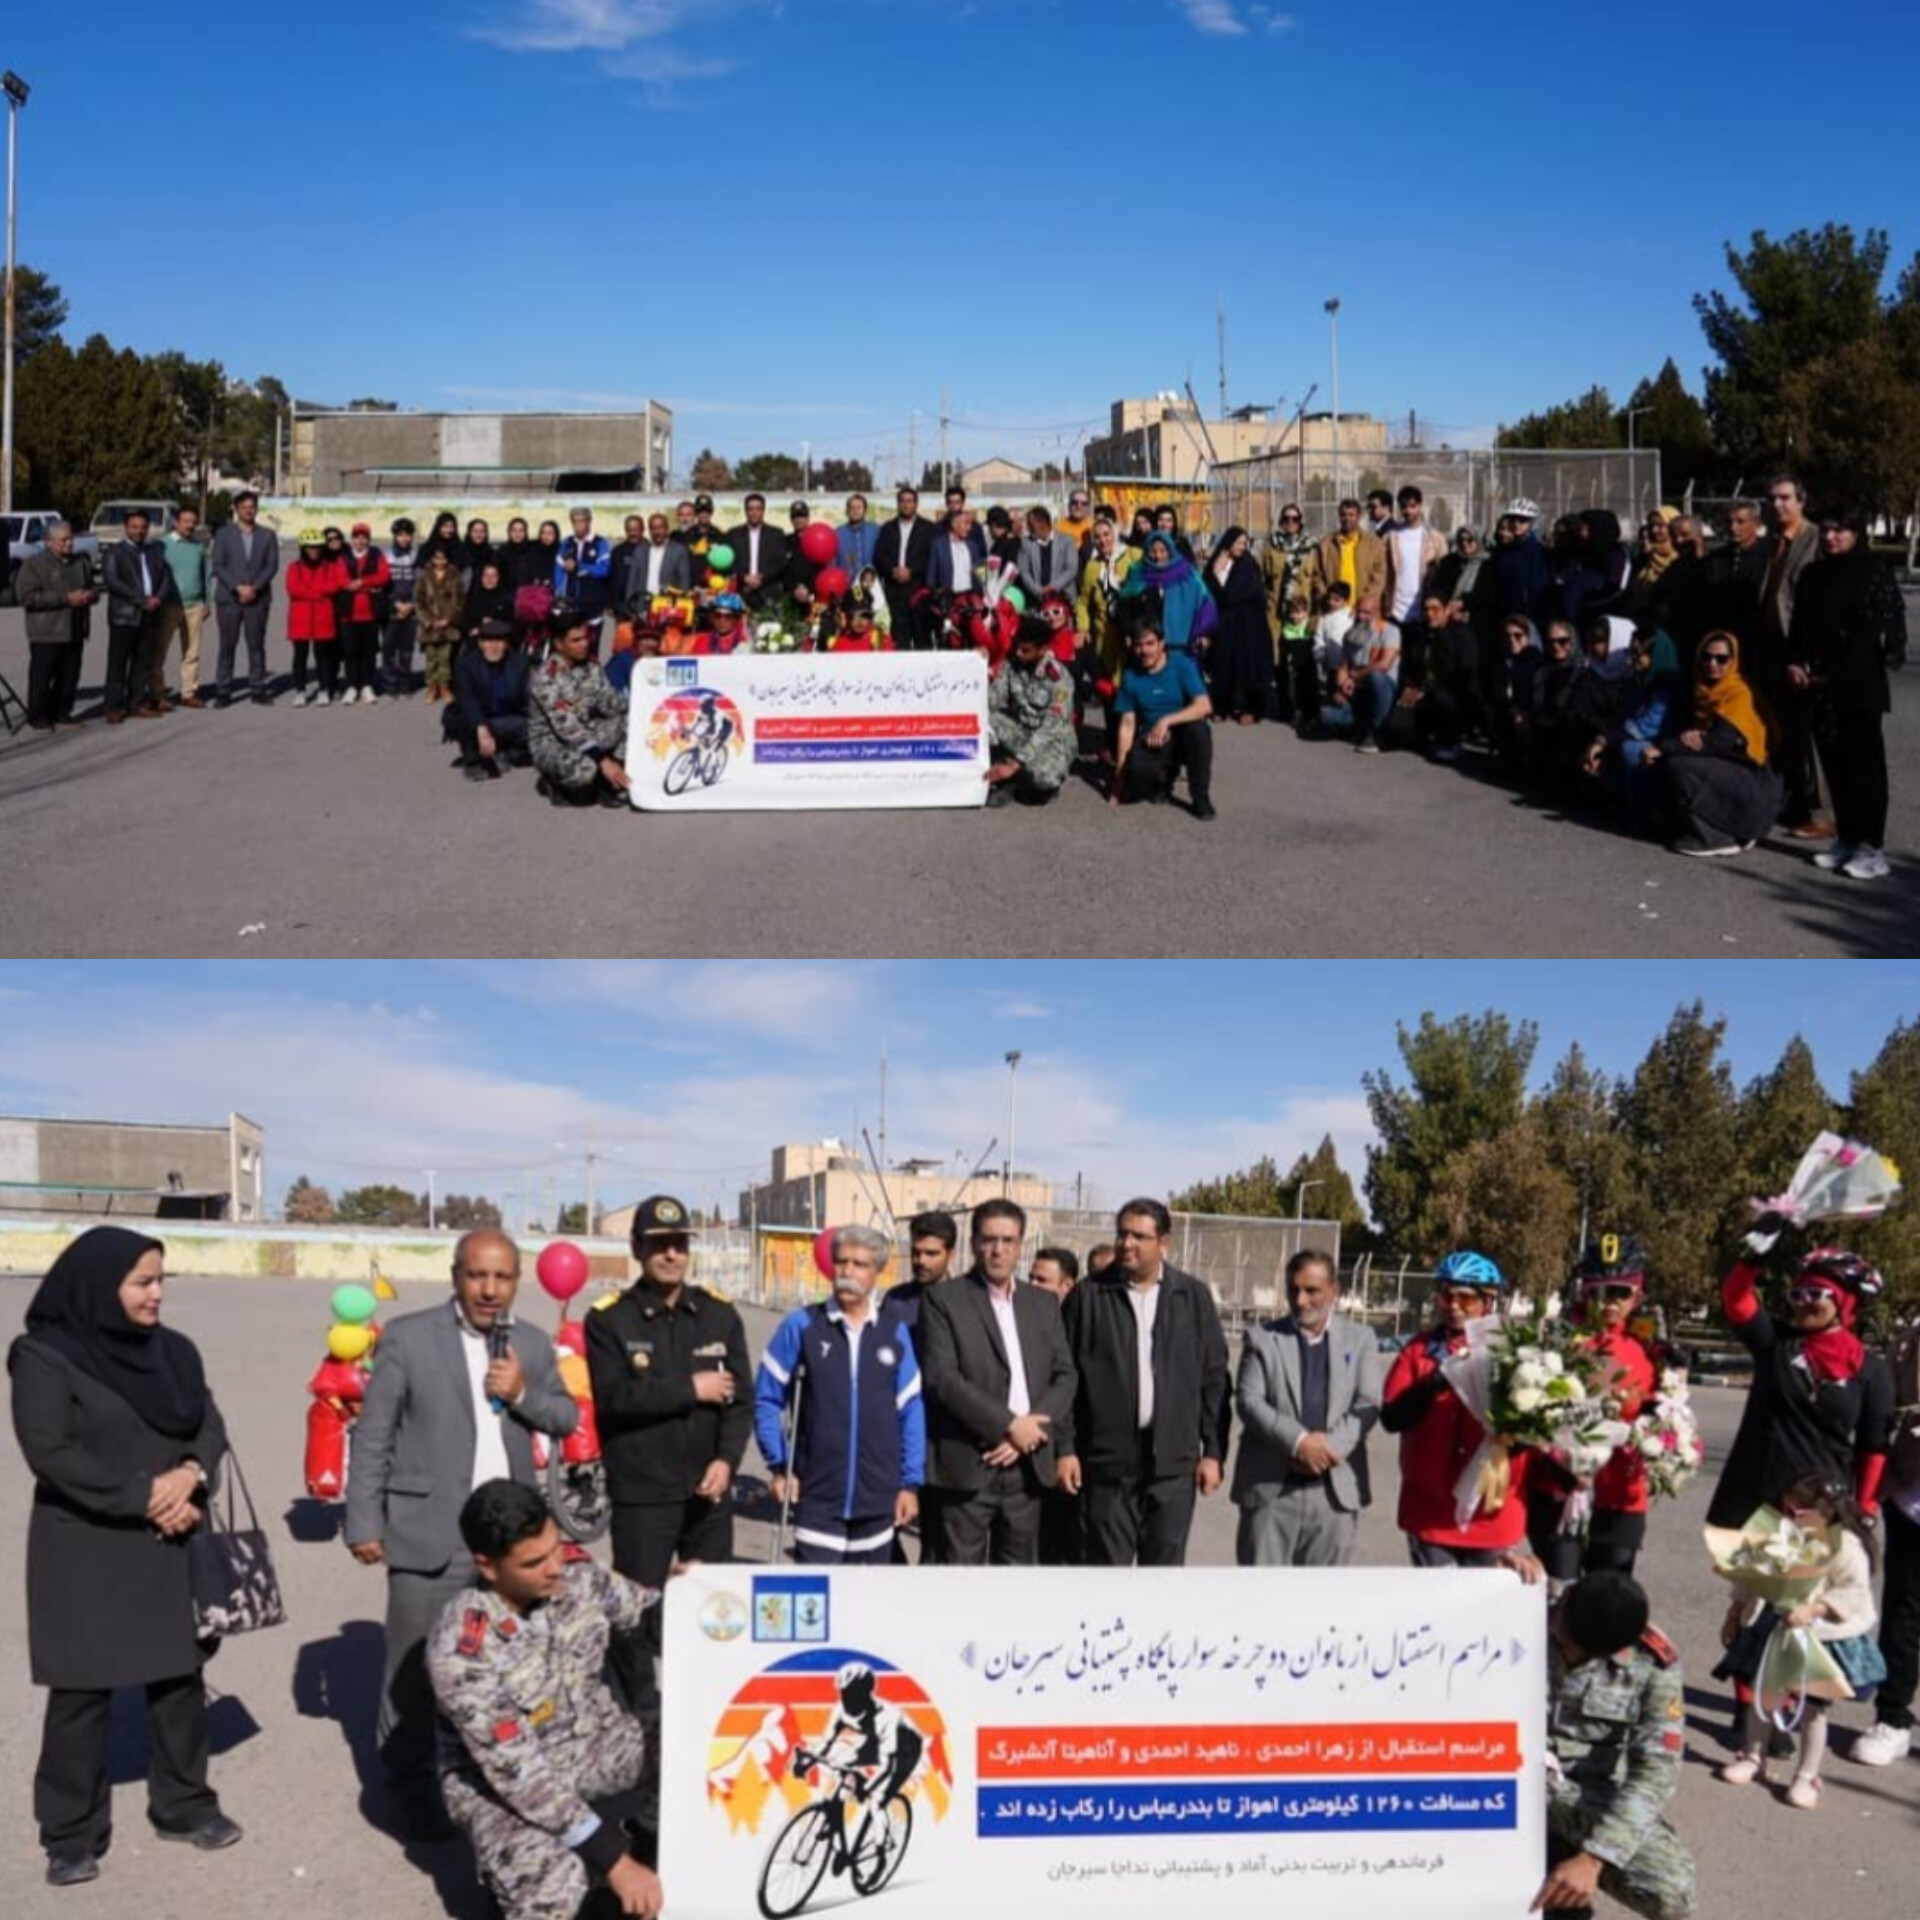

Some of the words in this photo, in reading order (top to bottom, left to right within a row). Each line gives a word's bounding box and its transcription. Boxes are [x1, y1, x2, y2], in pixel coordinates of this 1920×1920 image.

[1065, 1616, 1133, 1693] پشتیبانی
[1180, 1635, 1218, 1670] سوار
[1288, 1625, 1345, 1692] بانوان
[1348, 1633, 1369, 1669] از
[1371, 1624, 1445, 1692] استقبال
[984, 1641, 1064, 1695] سیرجان
[1135, 1629, 1178, 1698] پایگاه
[1447, 1634, 1502, 1699] مراسم
[1133, 1741, 1189, 1764] احمدی
[1256, 1741, 1310, 1762] احمدی
[1316, 1740, 1355, 1762] زهرا
[1358, 1738, 1374, 1761] از
[1377, 1737, 1446, 1760] استقبال
[1448, 1738, 1506, 1759] مراسم
[995, 1799, 1021, 1818] اند
[1026, 1799, 1058, 1822] زده
[1060, 1798, 1104, 1822] رکاب
[1108, 1799, 1124, 1820] را
[1128, 1797, 1213, 1821] بندرعباس
[1216, 1797, 1231, 1814] تا
[1234, 1796, 1279, 1819] اهواز
[1283, 1794, 1359, 1818] کیلومتری
[1419, 1793, 1481, 1811] مسافت
[1483, 1793, 1506, 1811] که
